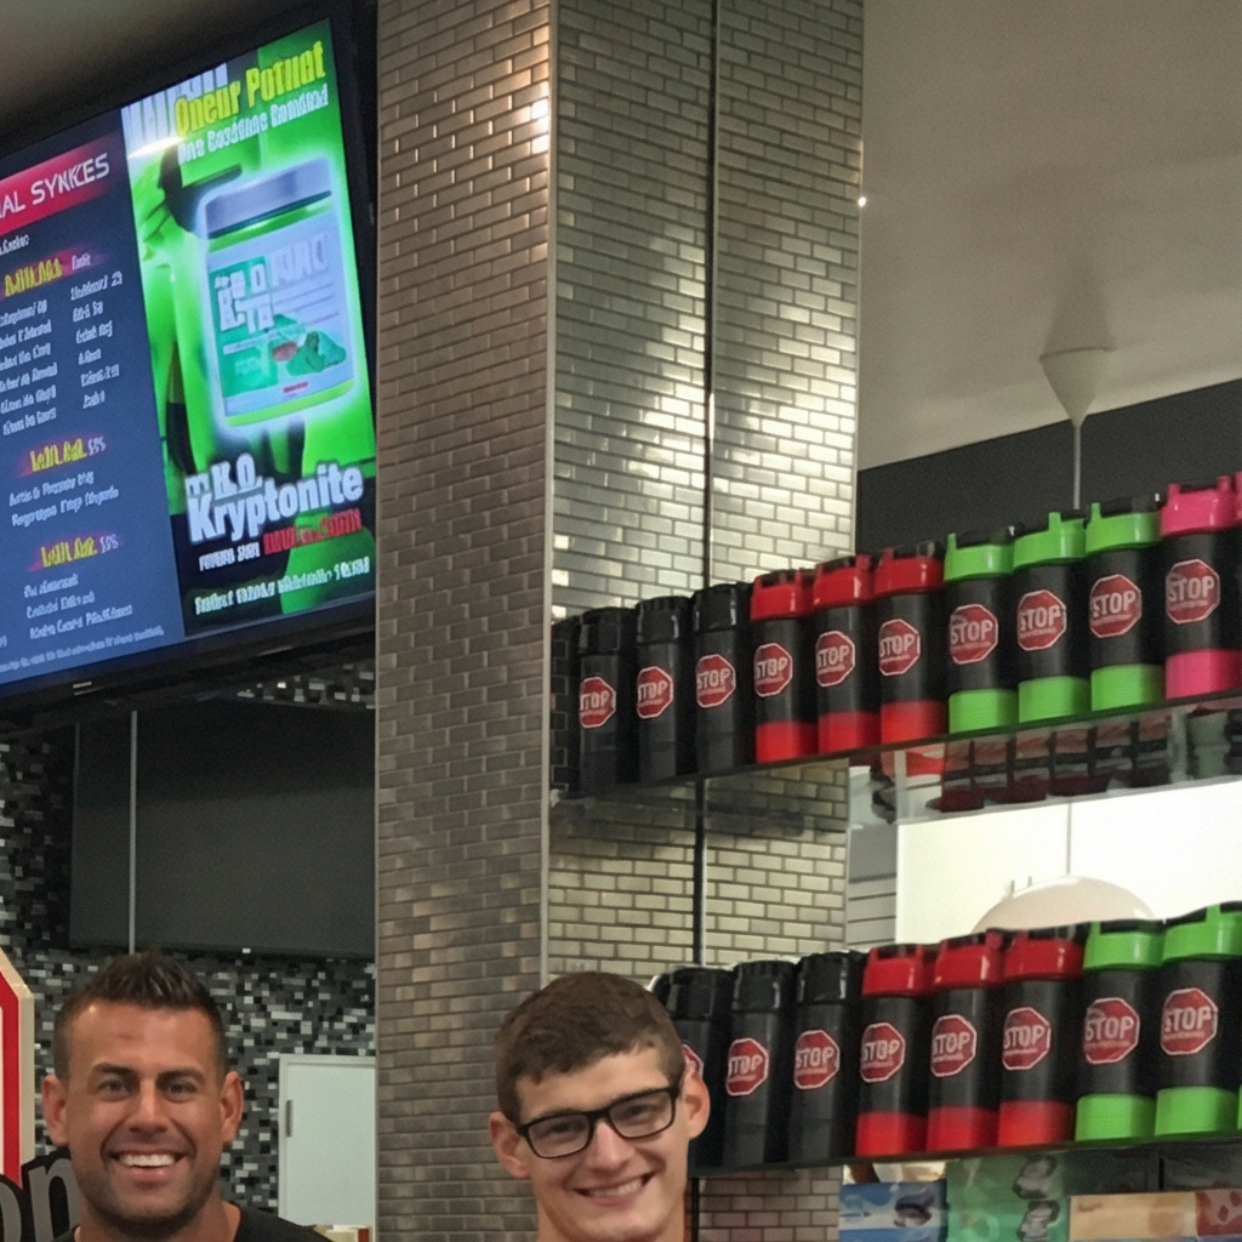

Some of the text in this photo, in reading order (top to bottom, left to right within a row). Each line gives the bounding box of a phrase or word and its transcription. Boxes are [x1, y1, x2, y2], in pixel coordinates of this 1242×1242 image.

[188, 463, 364, 545] Kryptonite
[1168, 575, 1215, 602] STOP
[1092, 590, 1136, 618] STOP
[951, 618, 994, 645] STOP
[1019, 605, 1061, 631] STOP
[1086, 1015, 1134, 1042] STOP
[1163, 1006, 1211, 1033] STOP
